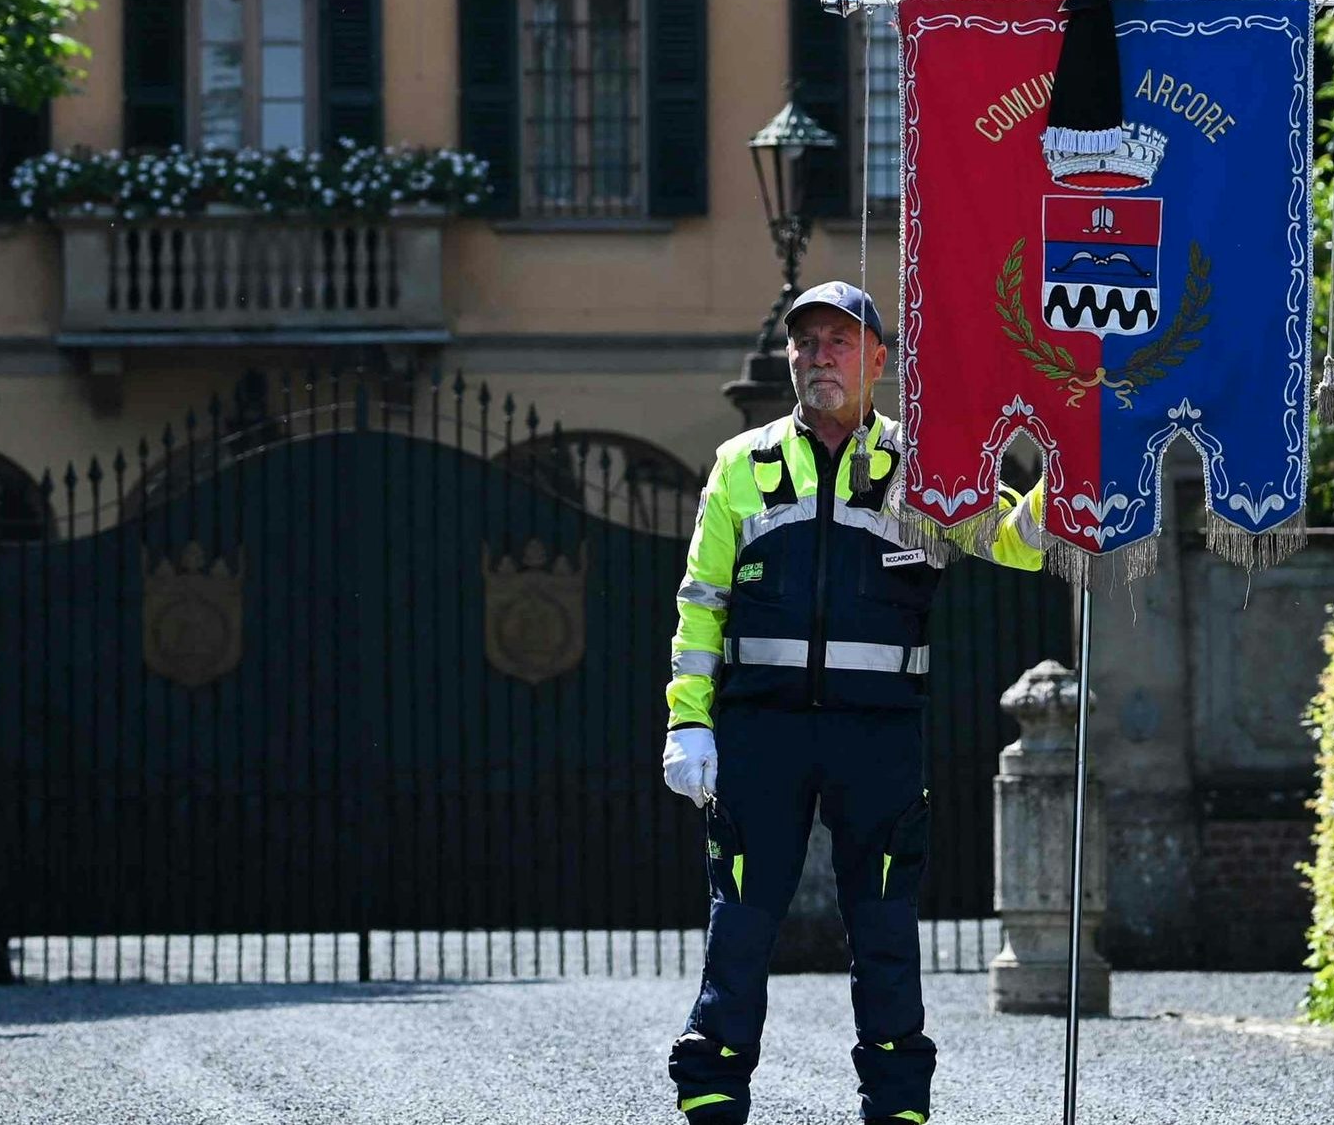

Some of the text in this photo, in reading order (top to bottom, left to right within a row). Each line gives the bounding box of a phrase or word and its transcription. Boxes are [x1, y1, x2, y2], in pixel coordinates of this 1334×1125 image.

[975, 68, 1236, 144] COMUN ARCORE
[885, 553, 914, 563] RICCARDO
